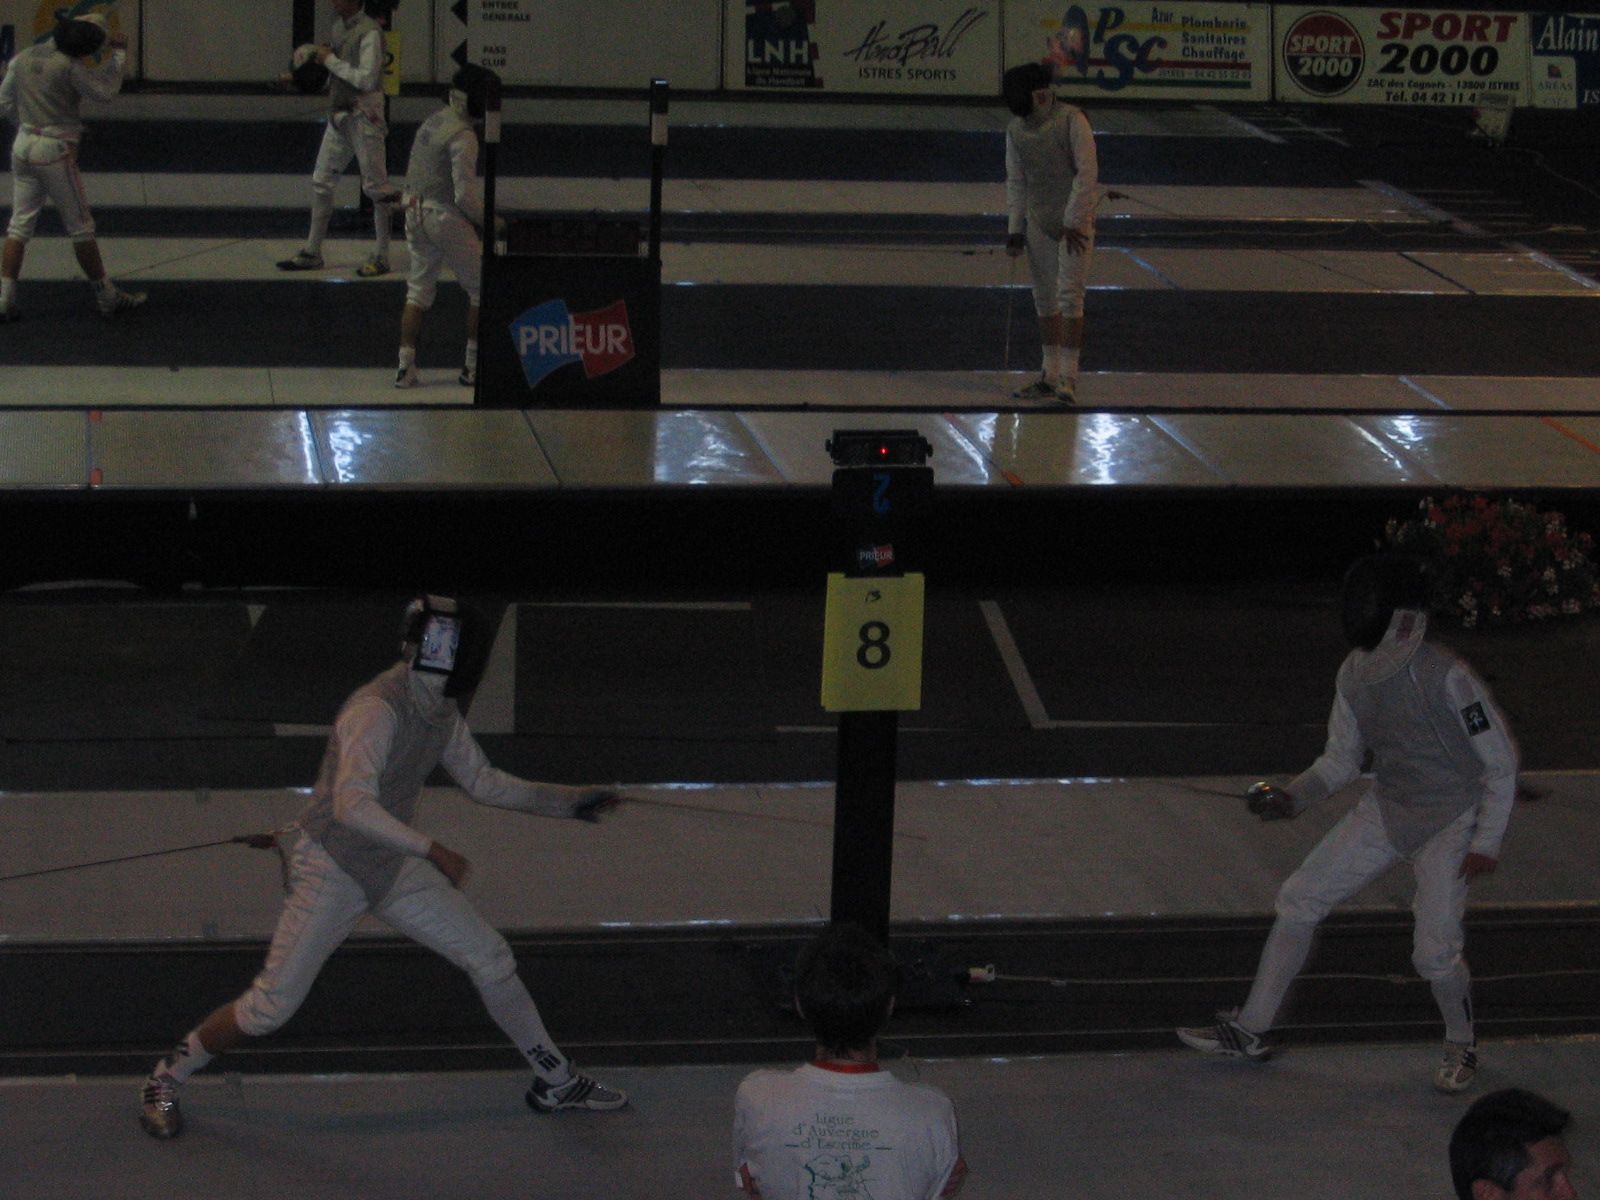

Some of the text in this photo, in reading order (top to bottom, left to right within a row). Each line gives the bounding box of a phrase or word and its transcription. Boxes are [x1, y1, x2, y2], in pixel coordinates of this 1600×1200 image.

[1181, 16, 1247, 30] Plomberie
[1377, 12, 1518, 42] SPORT
[1536, 15, 1600, 51] Alain
[1181, 32, 1247, 45] Sanitaires
[1289, 34, 1355, 54] SPORT
[747, 39, 809, 63] LNH
[1181, 46, 1246, 62] Chauffage
[1377, 43, 1499, 76] 2000
[859, 67, 957, 80] ISTRES SPORTS
[1297, 56, 1354, 77] 2000
[1457, 81, 1486, 90] 13800
[1488, 81, 1520, 90] ISTRES
[1411, 92, 1427, 102] 04
[1431, 92, 1447, 103] 42
[518, 314, 629, 356] PRIEUR
[859, 549, 894, 561] PRIEUR
[857, 621, 891, 669] 8
